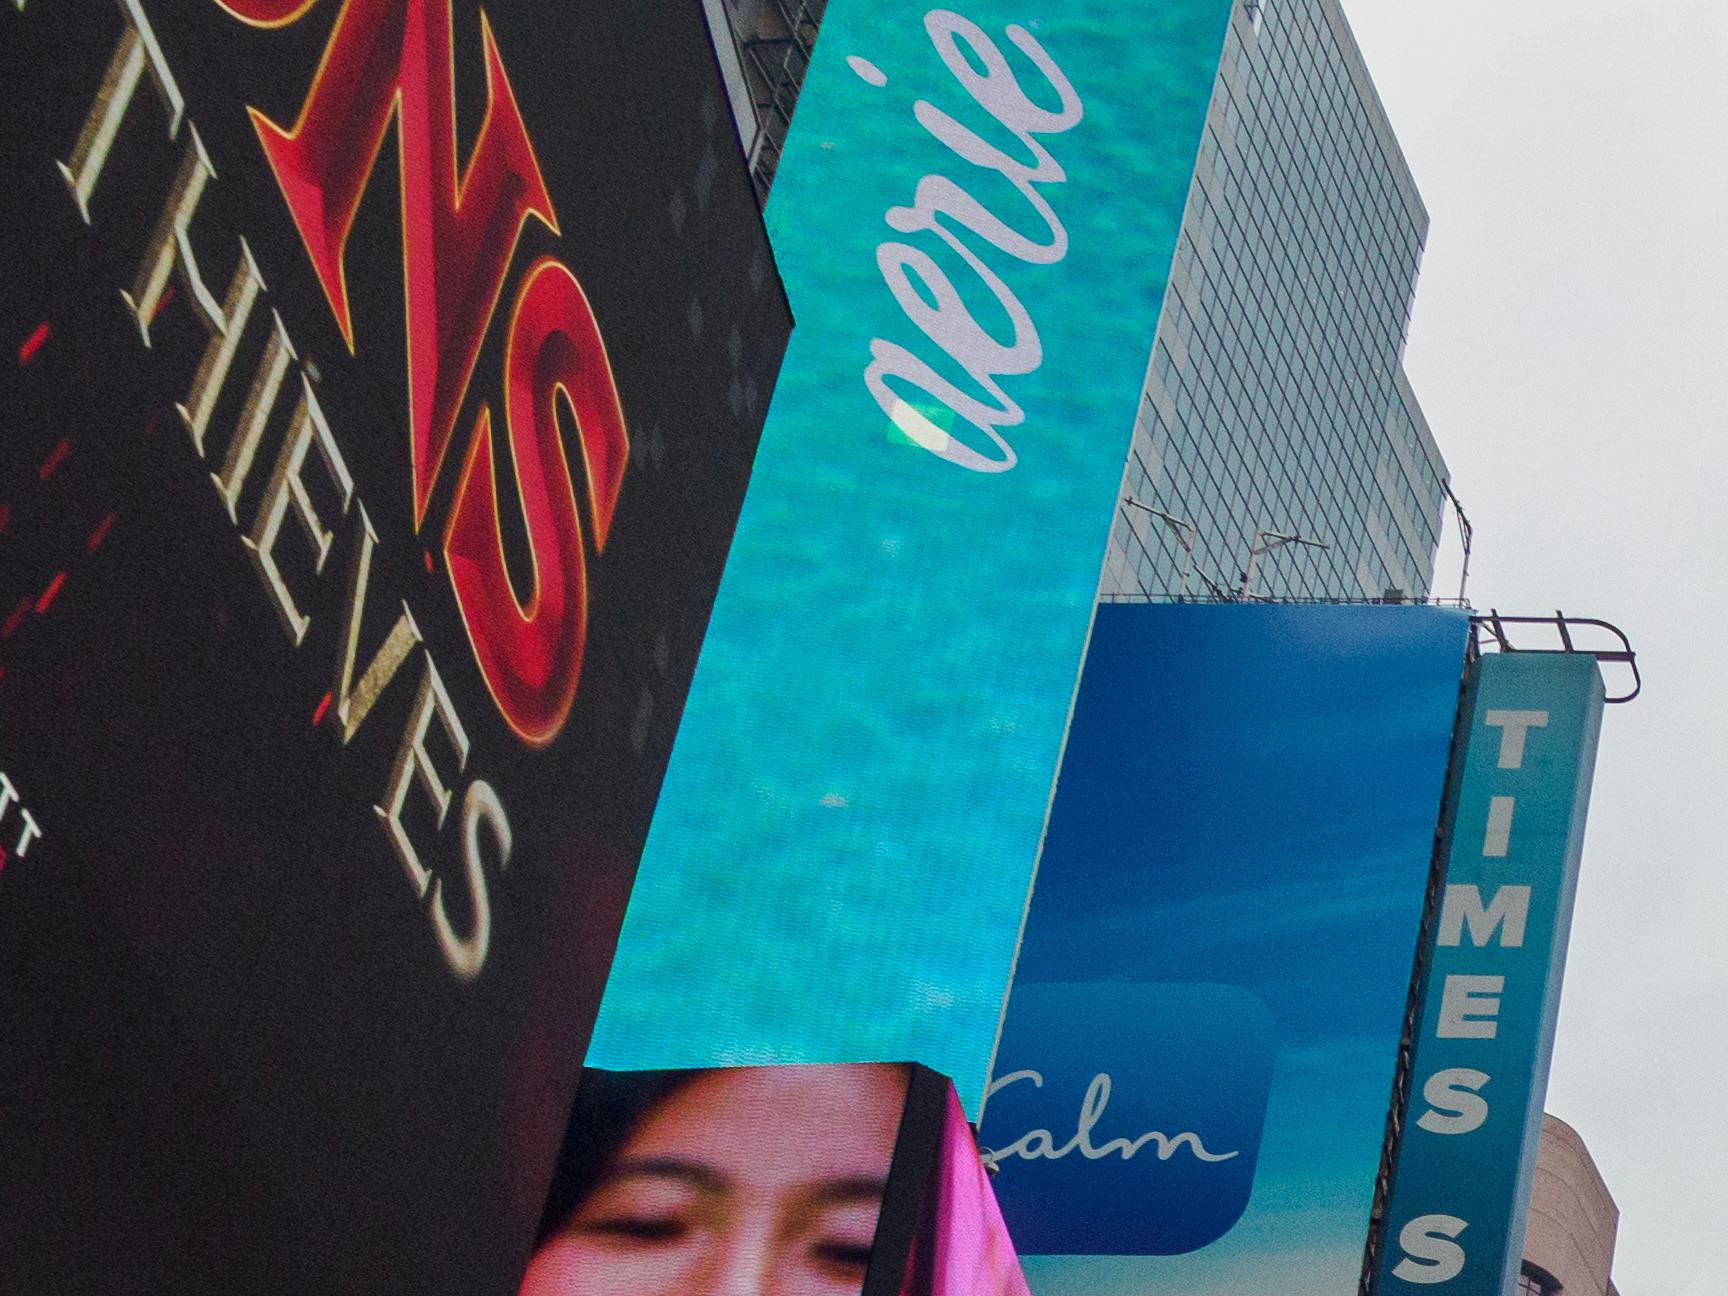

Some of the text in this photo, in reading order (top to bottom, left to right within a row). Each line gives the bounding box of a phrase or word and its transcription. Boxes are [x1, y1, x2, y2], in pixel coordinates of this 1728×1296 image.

[846, 8, 1084, 473] aerie
[56, 0, 513, 981] THIEVES
[1416, 708, 1550, 1135] TIMES
